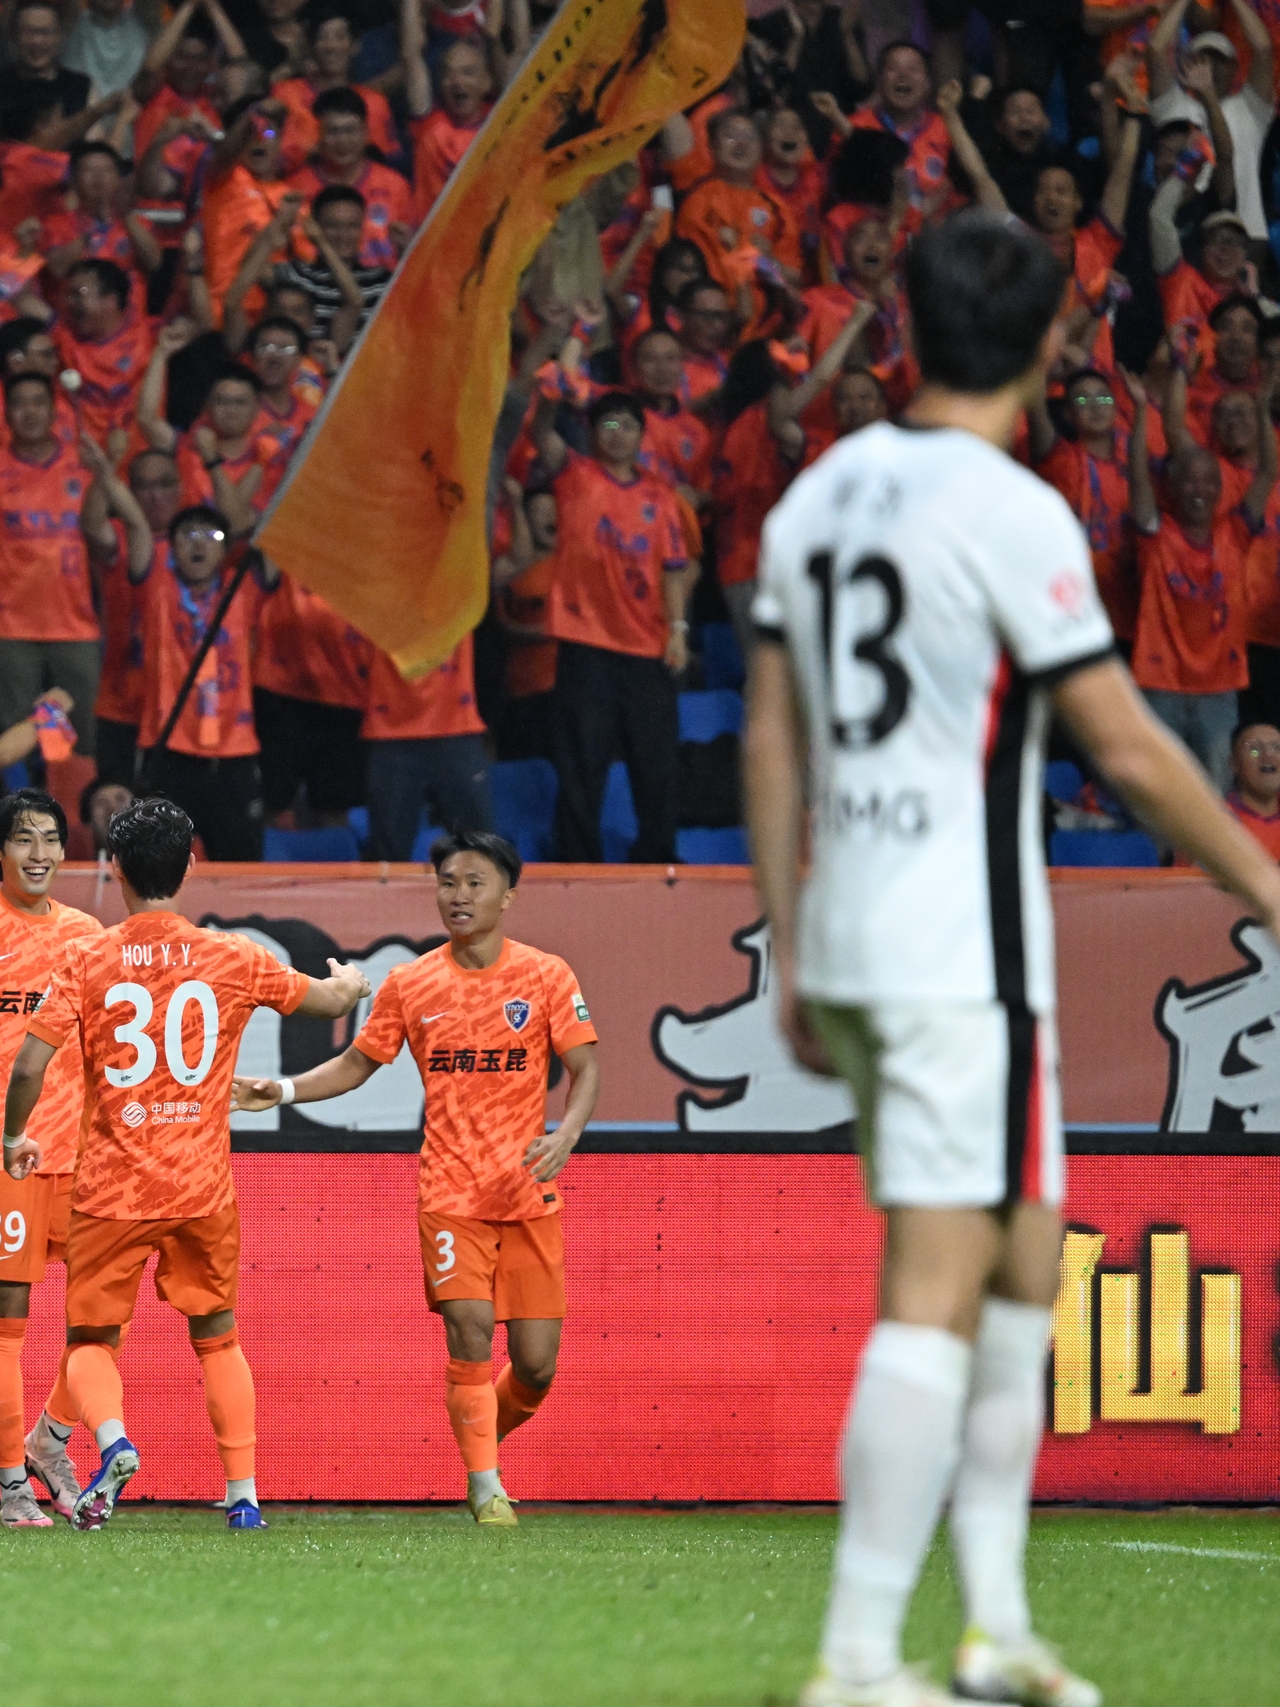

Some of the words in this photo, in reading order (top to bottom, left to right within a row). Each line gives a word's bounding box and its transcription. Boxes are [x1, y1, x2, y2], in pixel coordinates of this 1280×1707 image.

[806, 545, 914, 749] 13
[122, 944, 153, 967] HOU
[161, 943, 197, 966] Y.Y.
[104, 979, 219, 1088] 30
[428, 1048, 527, 1074] 云南玉昆
[151, 1101, 201, 1115] 中国移动
[151, 1116, 174, 1125] China
[175, 1115, 200, 1124] Mobile
[435, 1230, 456, 1272] 3
